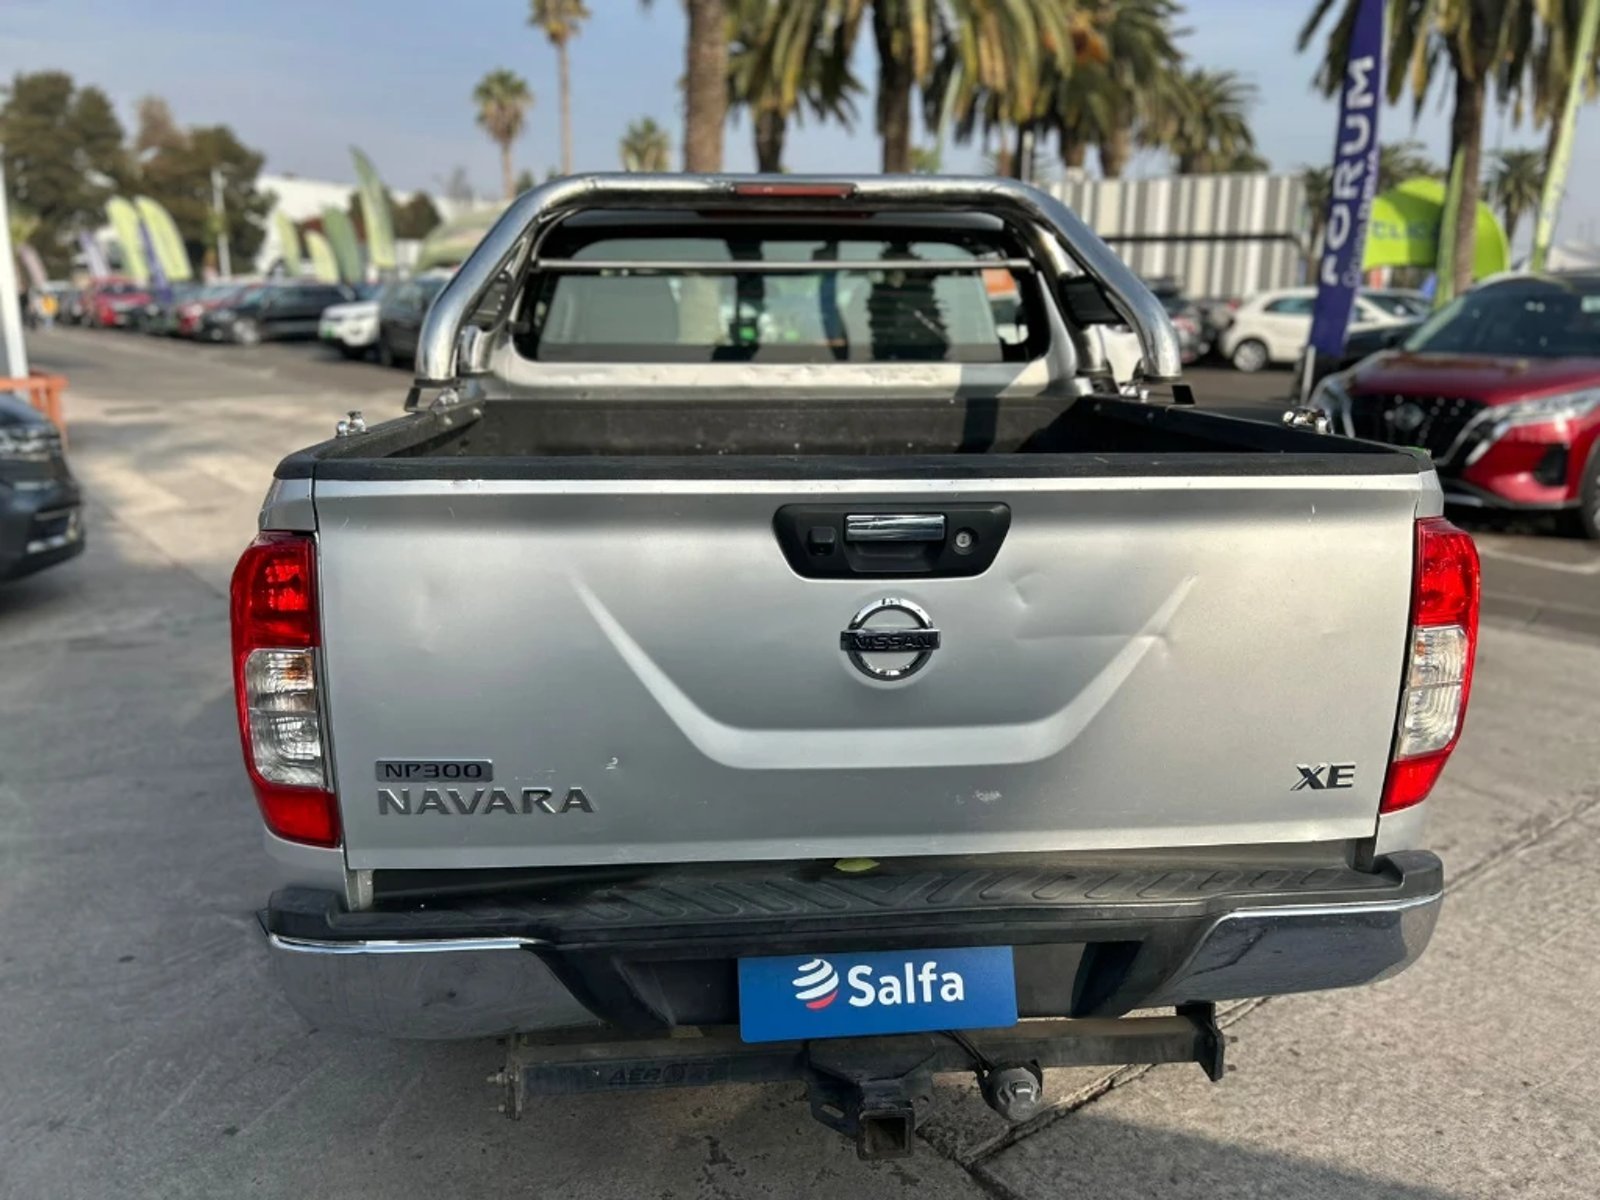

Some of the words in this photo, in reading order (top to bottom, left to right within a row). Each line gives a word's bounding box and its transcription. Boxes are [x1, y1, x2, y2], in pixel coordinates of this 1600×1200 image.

[1321, 56, 1375, 287] FORUM
[853, 635, 931, 649] NISSAN
[385, 763, 483, 779] NP300
[1290, 762, 1356, 791] XE
[376, 787, 594, 815] NAVARA
[847, 961, 964, 1007] Salfa
